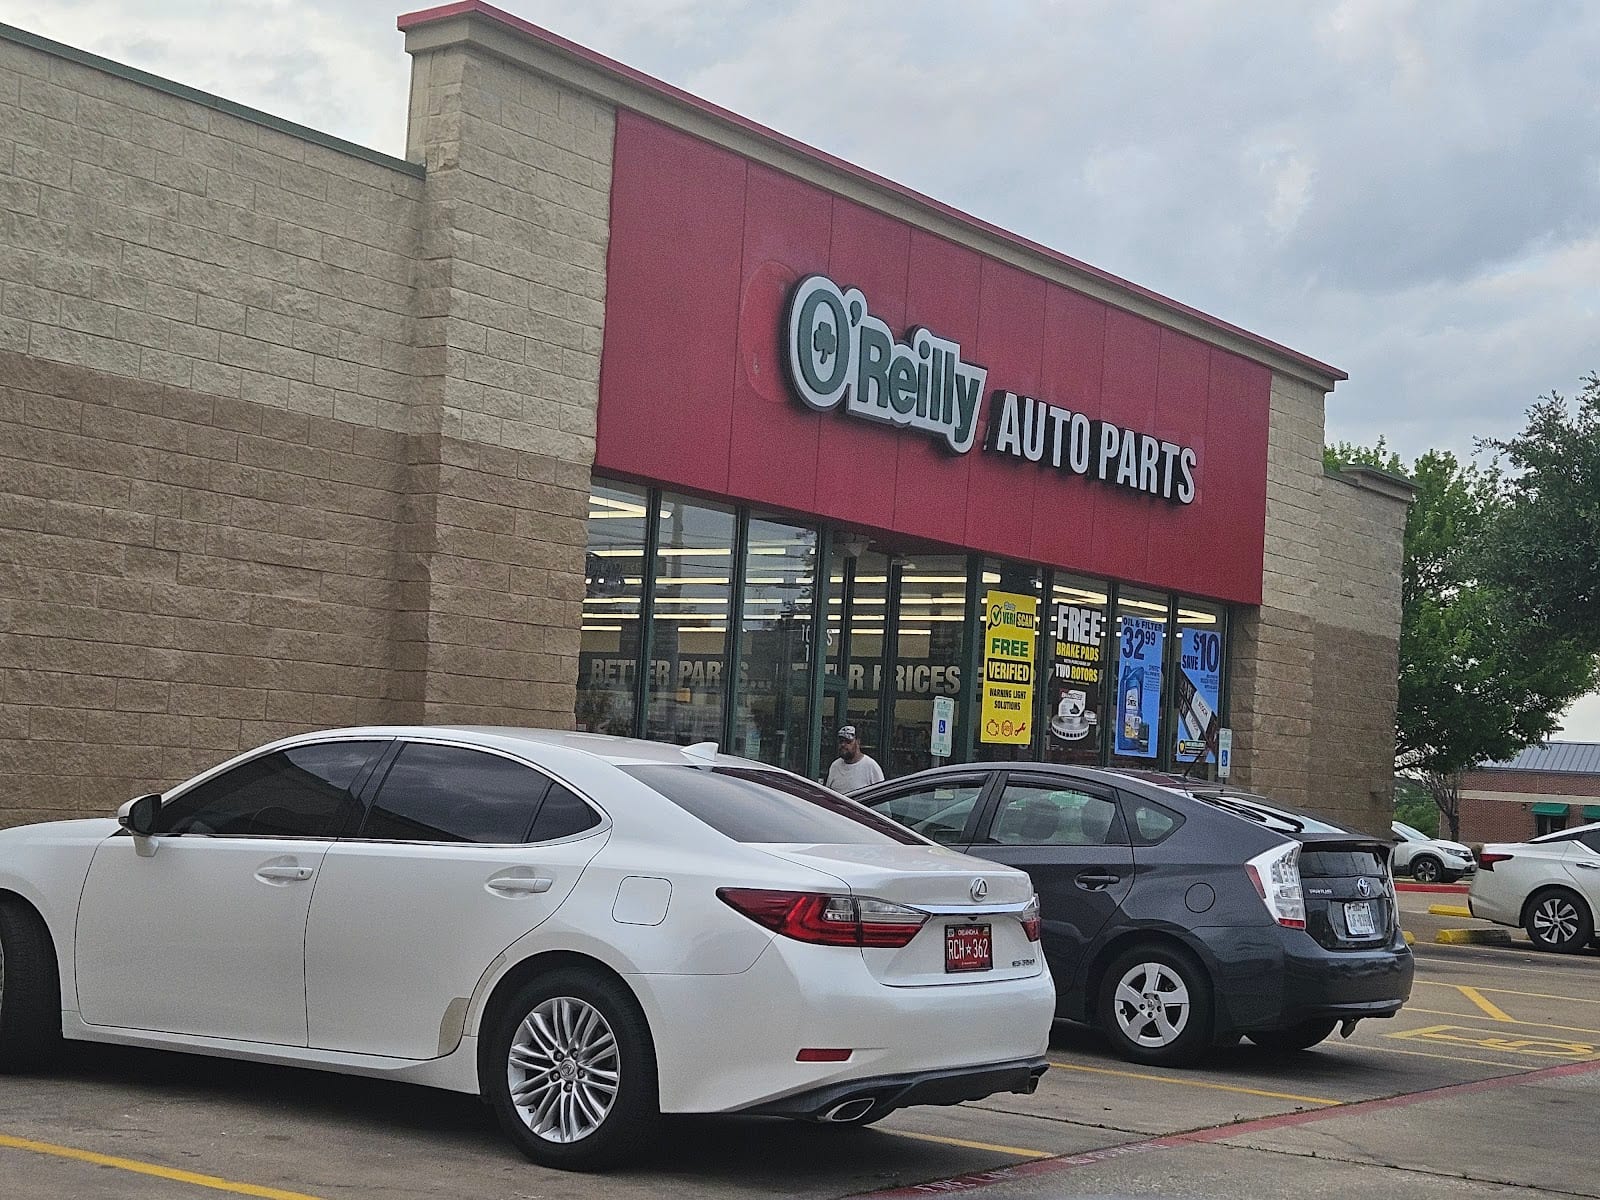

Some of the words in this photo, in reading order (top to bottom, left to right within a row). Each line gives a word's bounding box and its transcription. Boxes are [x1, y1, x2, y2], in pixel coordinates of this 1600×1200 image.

[796, 284, 983, 447] O'Reilly
[997, 391, 1091, 475] AUTO
[1098, 421, 1198, 504] PARTS
[1056, 603, 1102, 647] FREE
[1123, 617, 1135, 627] OIL
[1141, 620, 1163, 632] FILTER
[991, 637, 1029, 658] FREE
[1056, 641, 1080, 659] BRAKE
[1080, 644, 1100, 662] PADS
[1193, 633, 1220, 673] $10
[987, 660, 1030, 682] VERIFIED
[1182, 654, 1199, 670] SAVE
[1055, 663, 1071, 679] TWO
[1071, 665, 1098, 683] ROTORS
[989, 687, 1012, 699] WARNING
[1013, 688, 1027, 700] LIGHT
[994, 700, 1021, 711] SOLUTIONS
